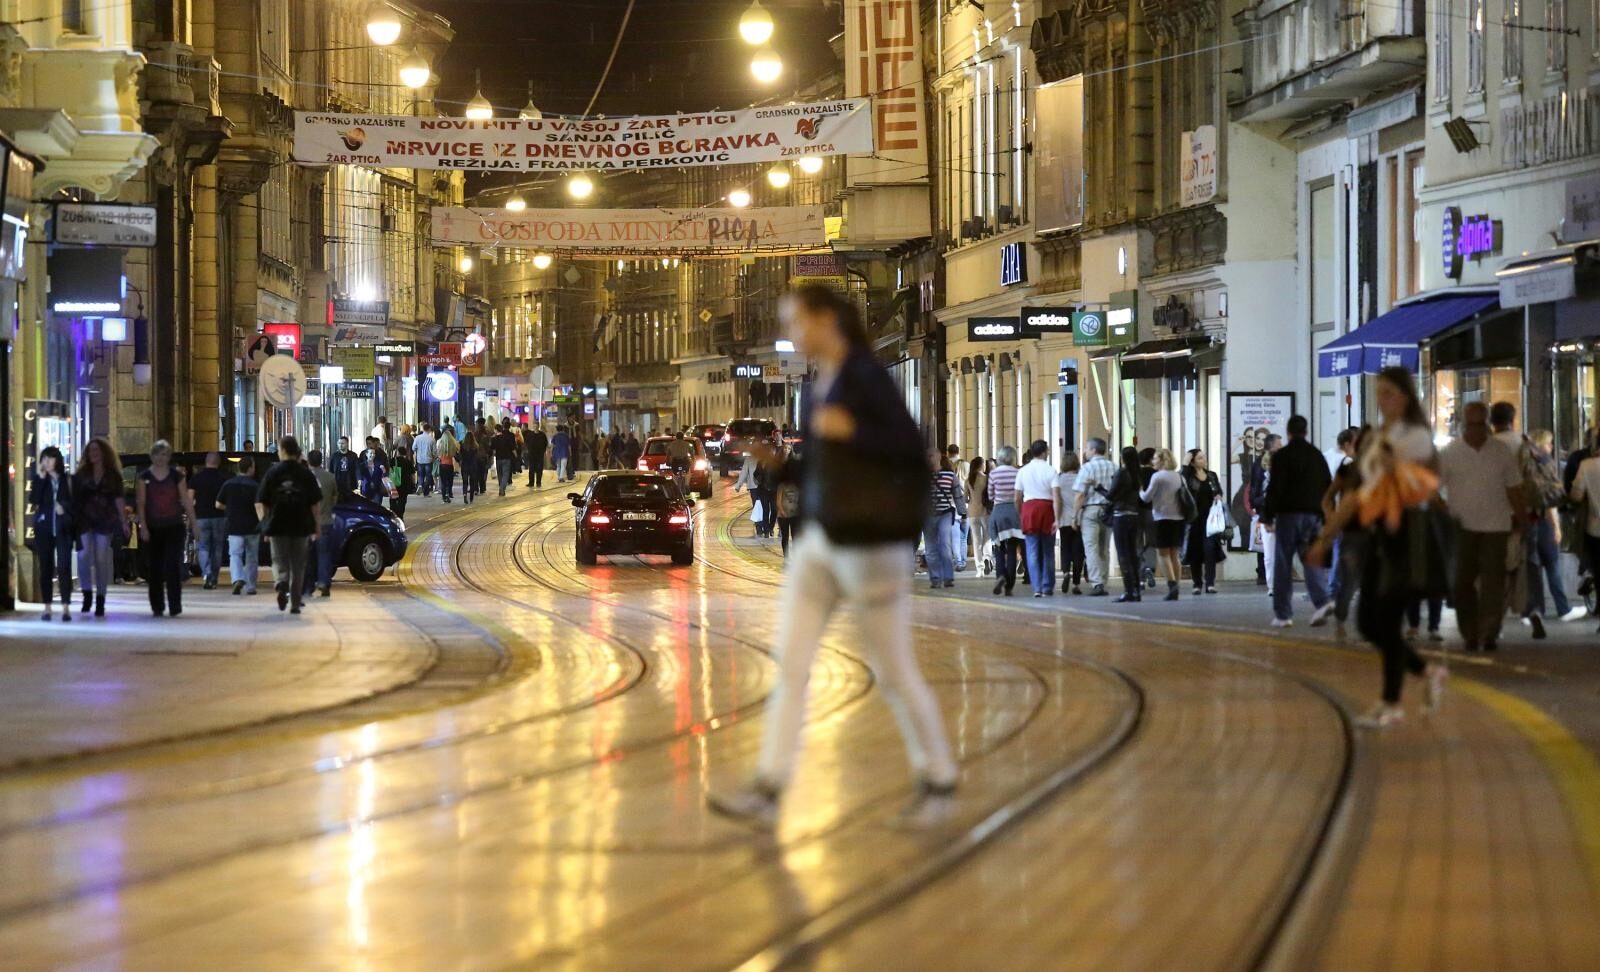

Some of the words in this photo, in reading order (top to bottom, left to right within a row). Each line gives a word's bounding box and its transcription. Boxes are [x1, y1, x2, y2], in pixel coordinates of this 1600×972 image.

[755, 106, 801, 119] GRADSKO
[802, 102, 854, 115] KAZALIŠTE
[353, 115, 406, 128] KAZALIŠTE
[528, 121, 542, 131] U
[551, 119, 620, 132] VAŠOJ
[627, 117, 671, 131] ŽAR
[678, 115, 736, 126] PTICI
[546, 132, 615, 143] SANJA
[386, 140, 484, 157] MRVICE
[494, 143, 517, 157] IZ
[525, 142, 650, 159] DNEVNOG
[659, 131, 781, 155] BORAVKA
[780, 144, 803, 156] ŽAR
[804, 142, 835, 153] PTICA
[326, 152, 349, 164] ŽAR
[349, 154, 381, 164] PTICA
[438, 157, 521, 169] REŽIJA:
[528, 159, 616, 170] FRANKA
[622, 151, 730, 168] PERKOVIĆ
[478, 220, 602, 241] GOSPOĐA
[1001, 242, 1021, 286] ZARA
[1027, 314, 1070, 326] adidas
[973, 323, 1015, 335] adidas
[420, 356, 446, 365] Triumph
